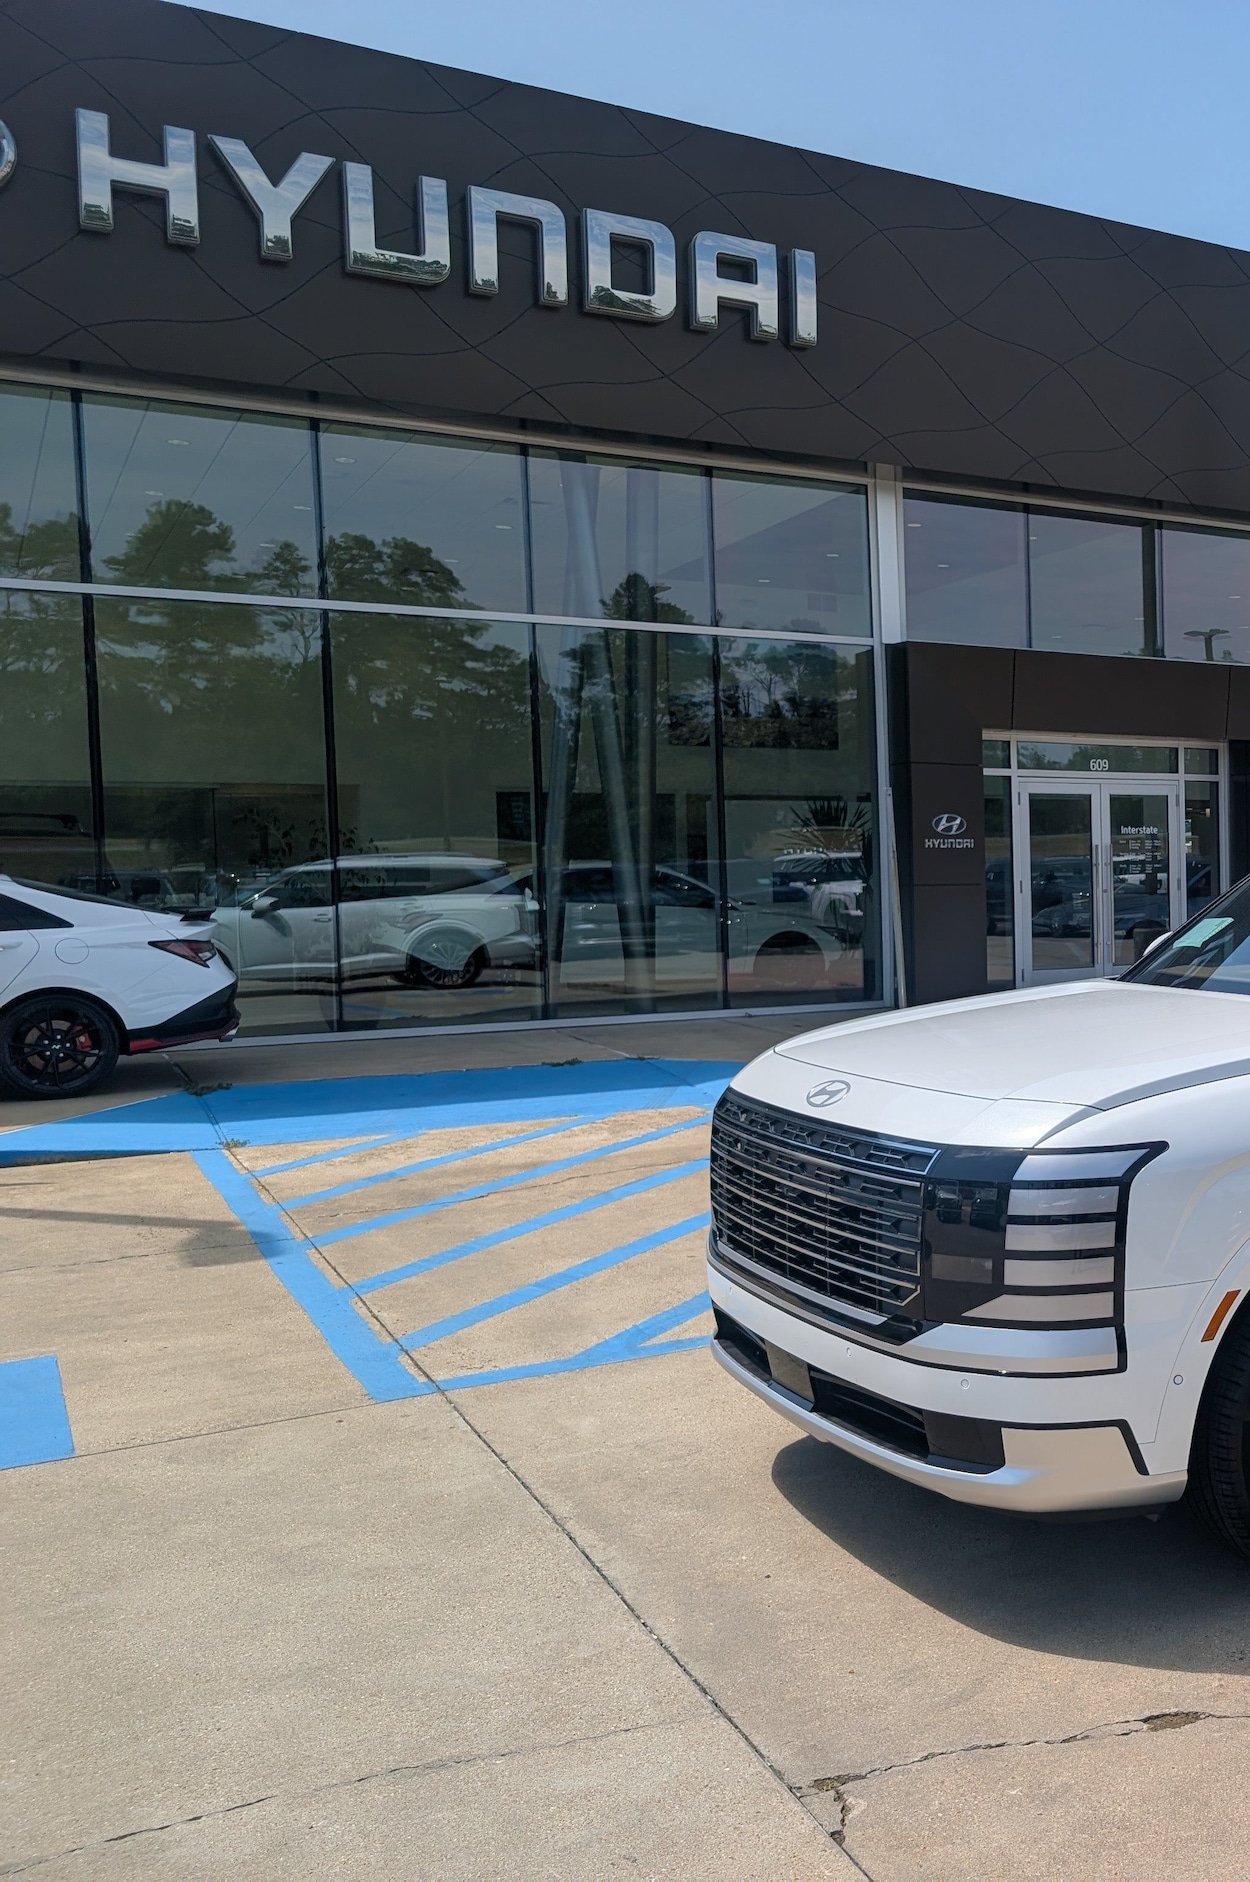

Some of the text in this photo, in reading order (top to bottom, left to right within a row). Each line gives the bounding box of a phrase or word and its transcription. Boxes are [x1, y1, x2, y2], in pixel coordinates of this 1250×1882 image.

[75, 107, 819, 348] HYUNDAI
[1090, 759, 1109, 771] 609
[1121, 826, 1158, 835] Interstate
[925, 838, 975, 849] HYUNDAI
